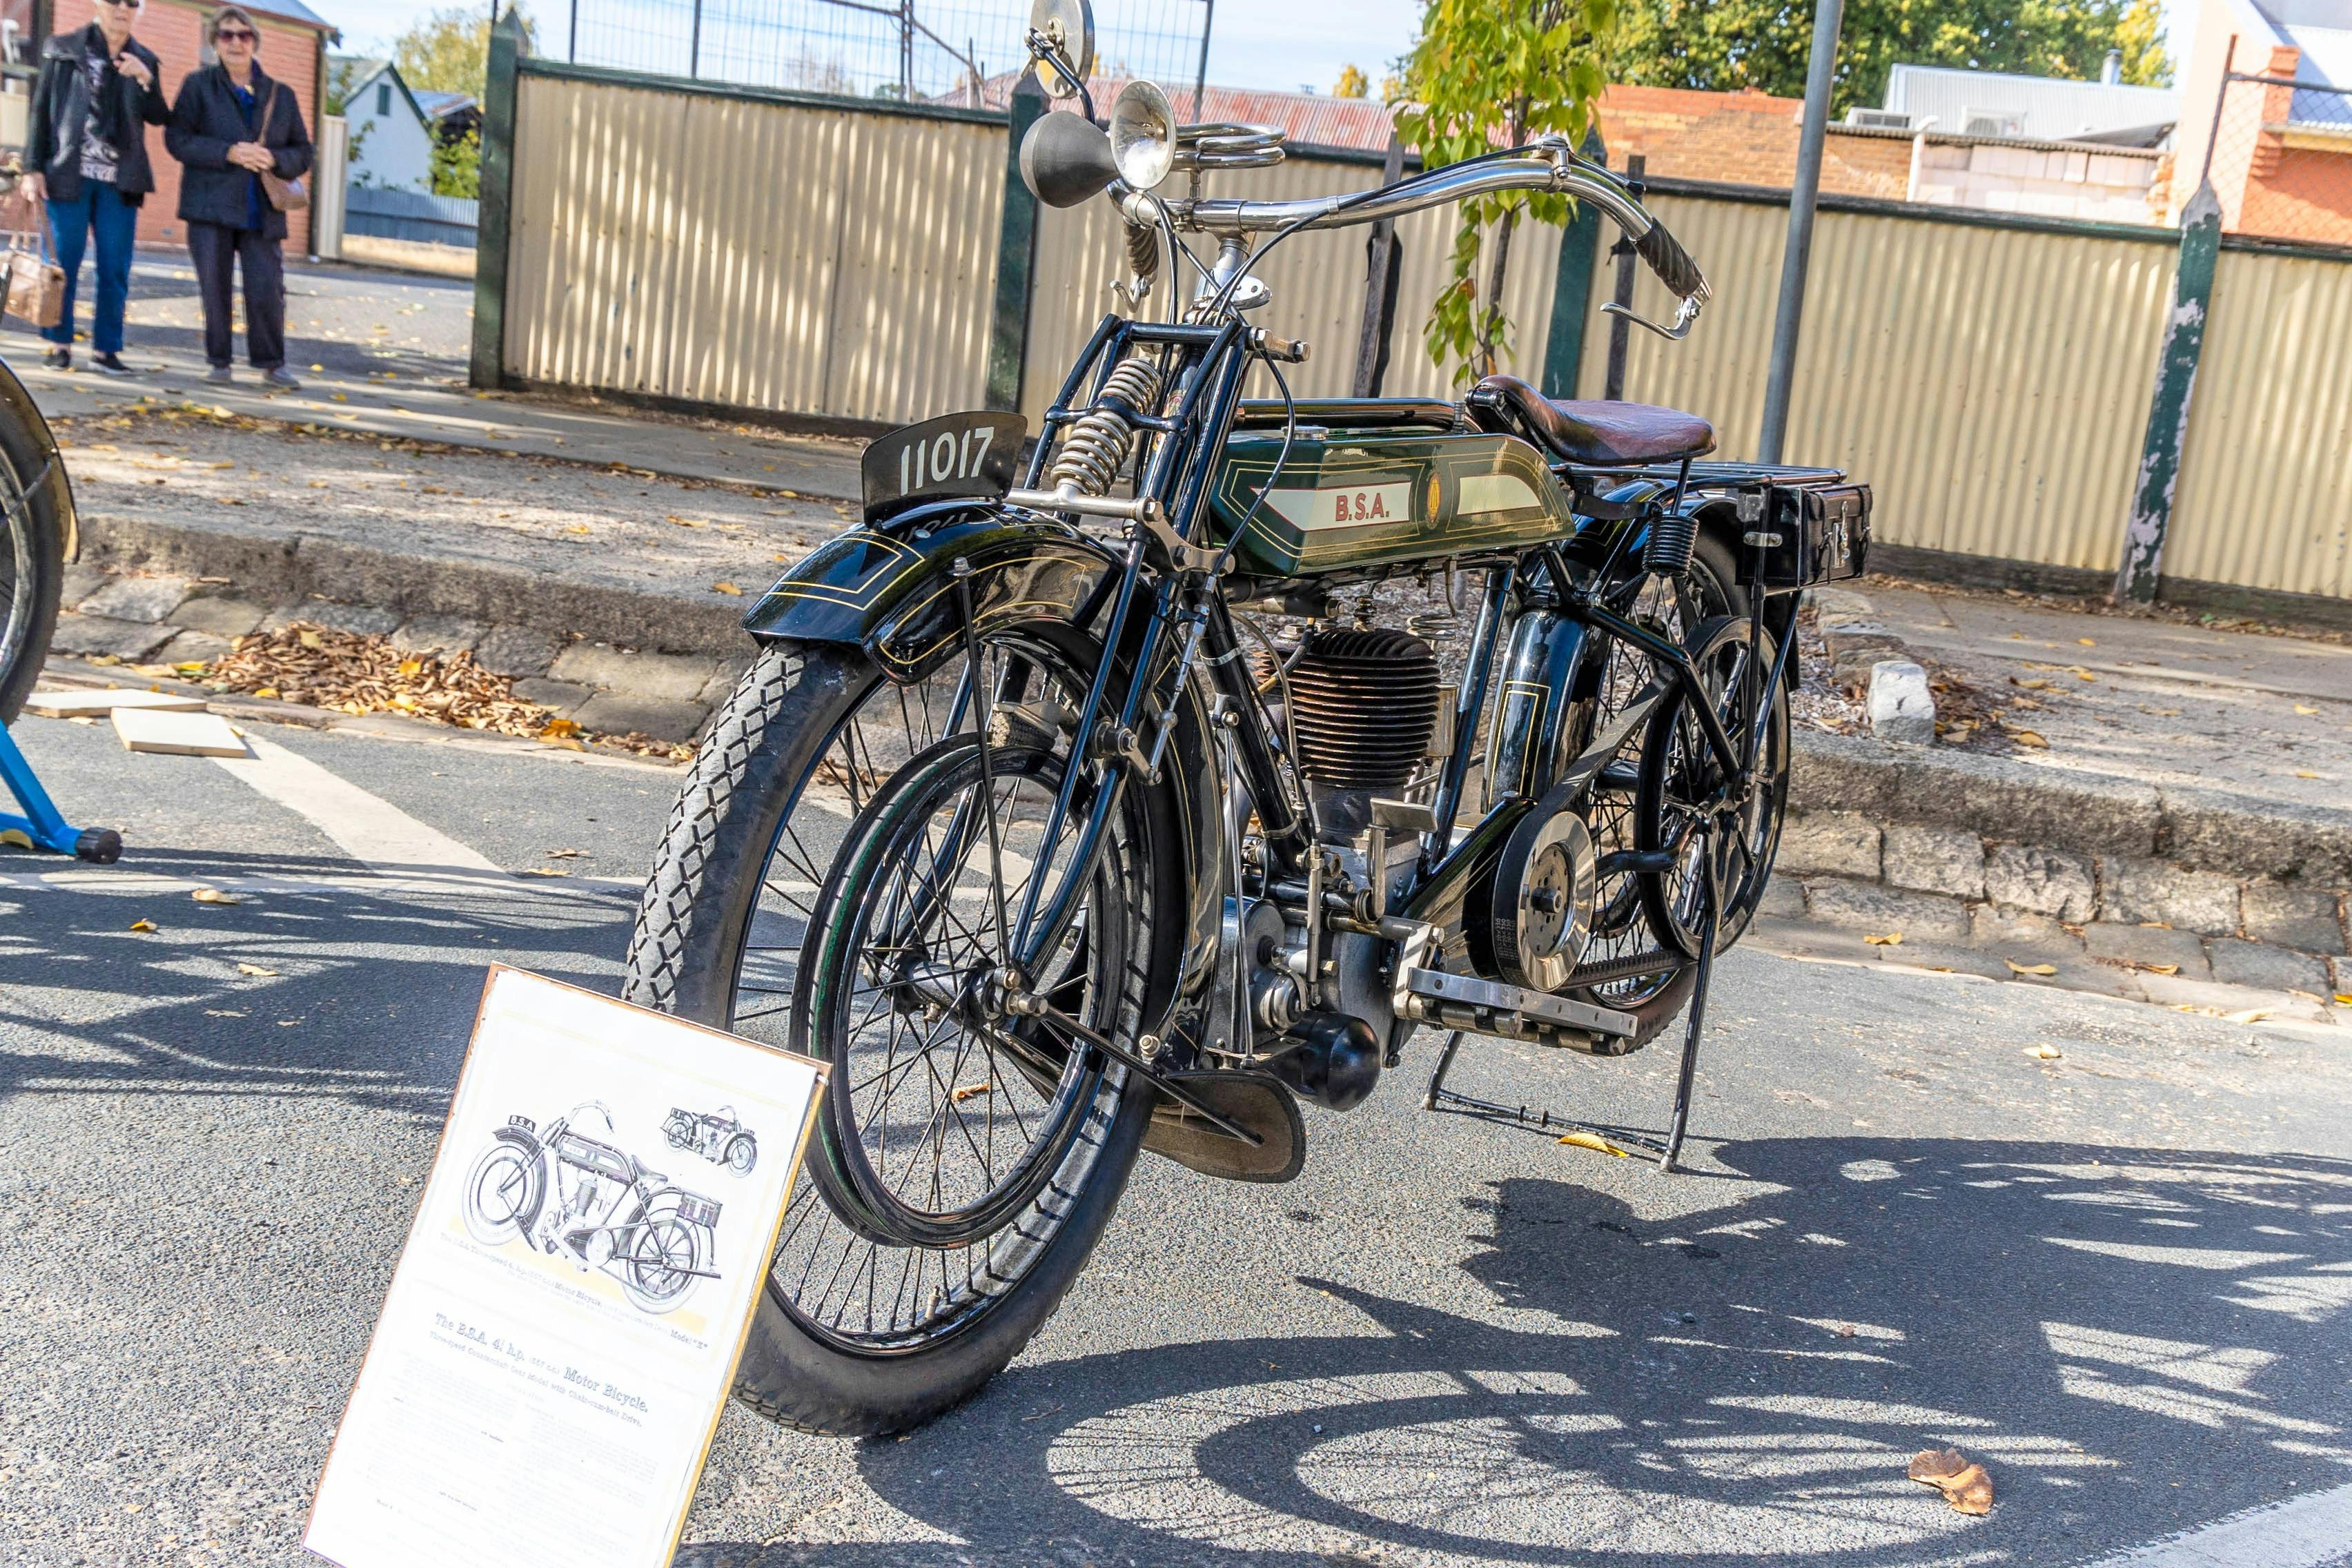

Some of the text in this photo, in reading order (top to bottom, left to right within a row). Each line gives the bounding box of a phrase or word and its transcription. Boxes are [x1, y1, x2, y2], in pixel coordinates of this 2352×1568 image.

[901, 427, 994, 496] 11017
[1335, 493, 1389, 521] B.S.A.
[435, 1312, 454, 1331] The
[456, 1322, 488, 1345] B.S.A.
[563, 1366, 600, 1392] Motor
[602, 1382, 648, 1413] Bicycle.
[551, 1383, 567, 1394] with
